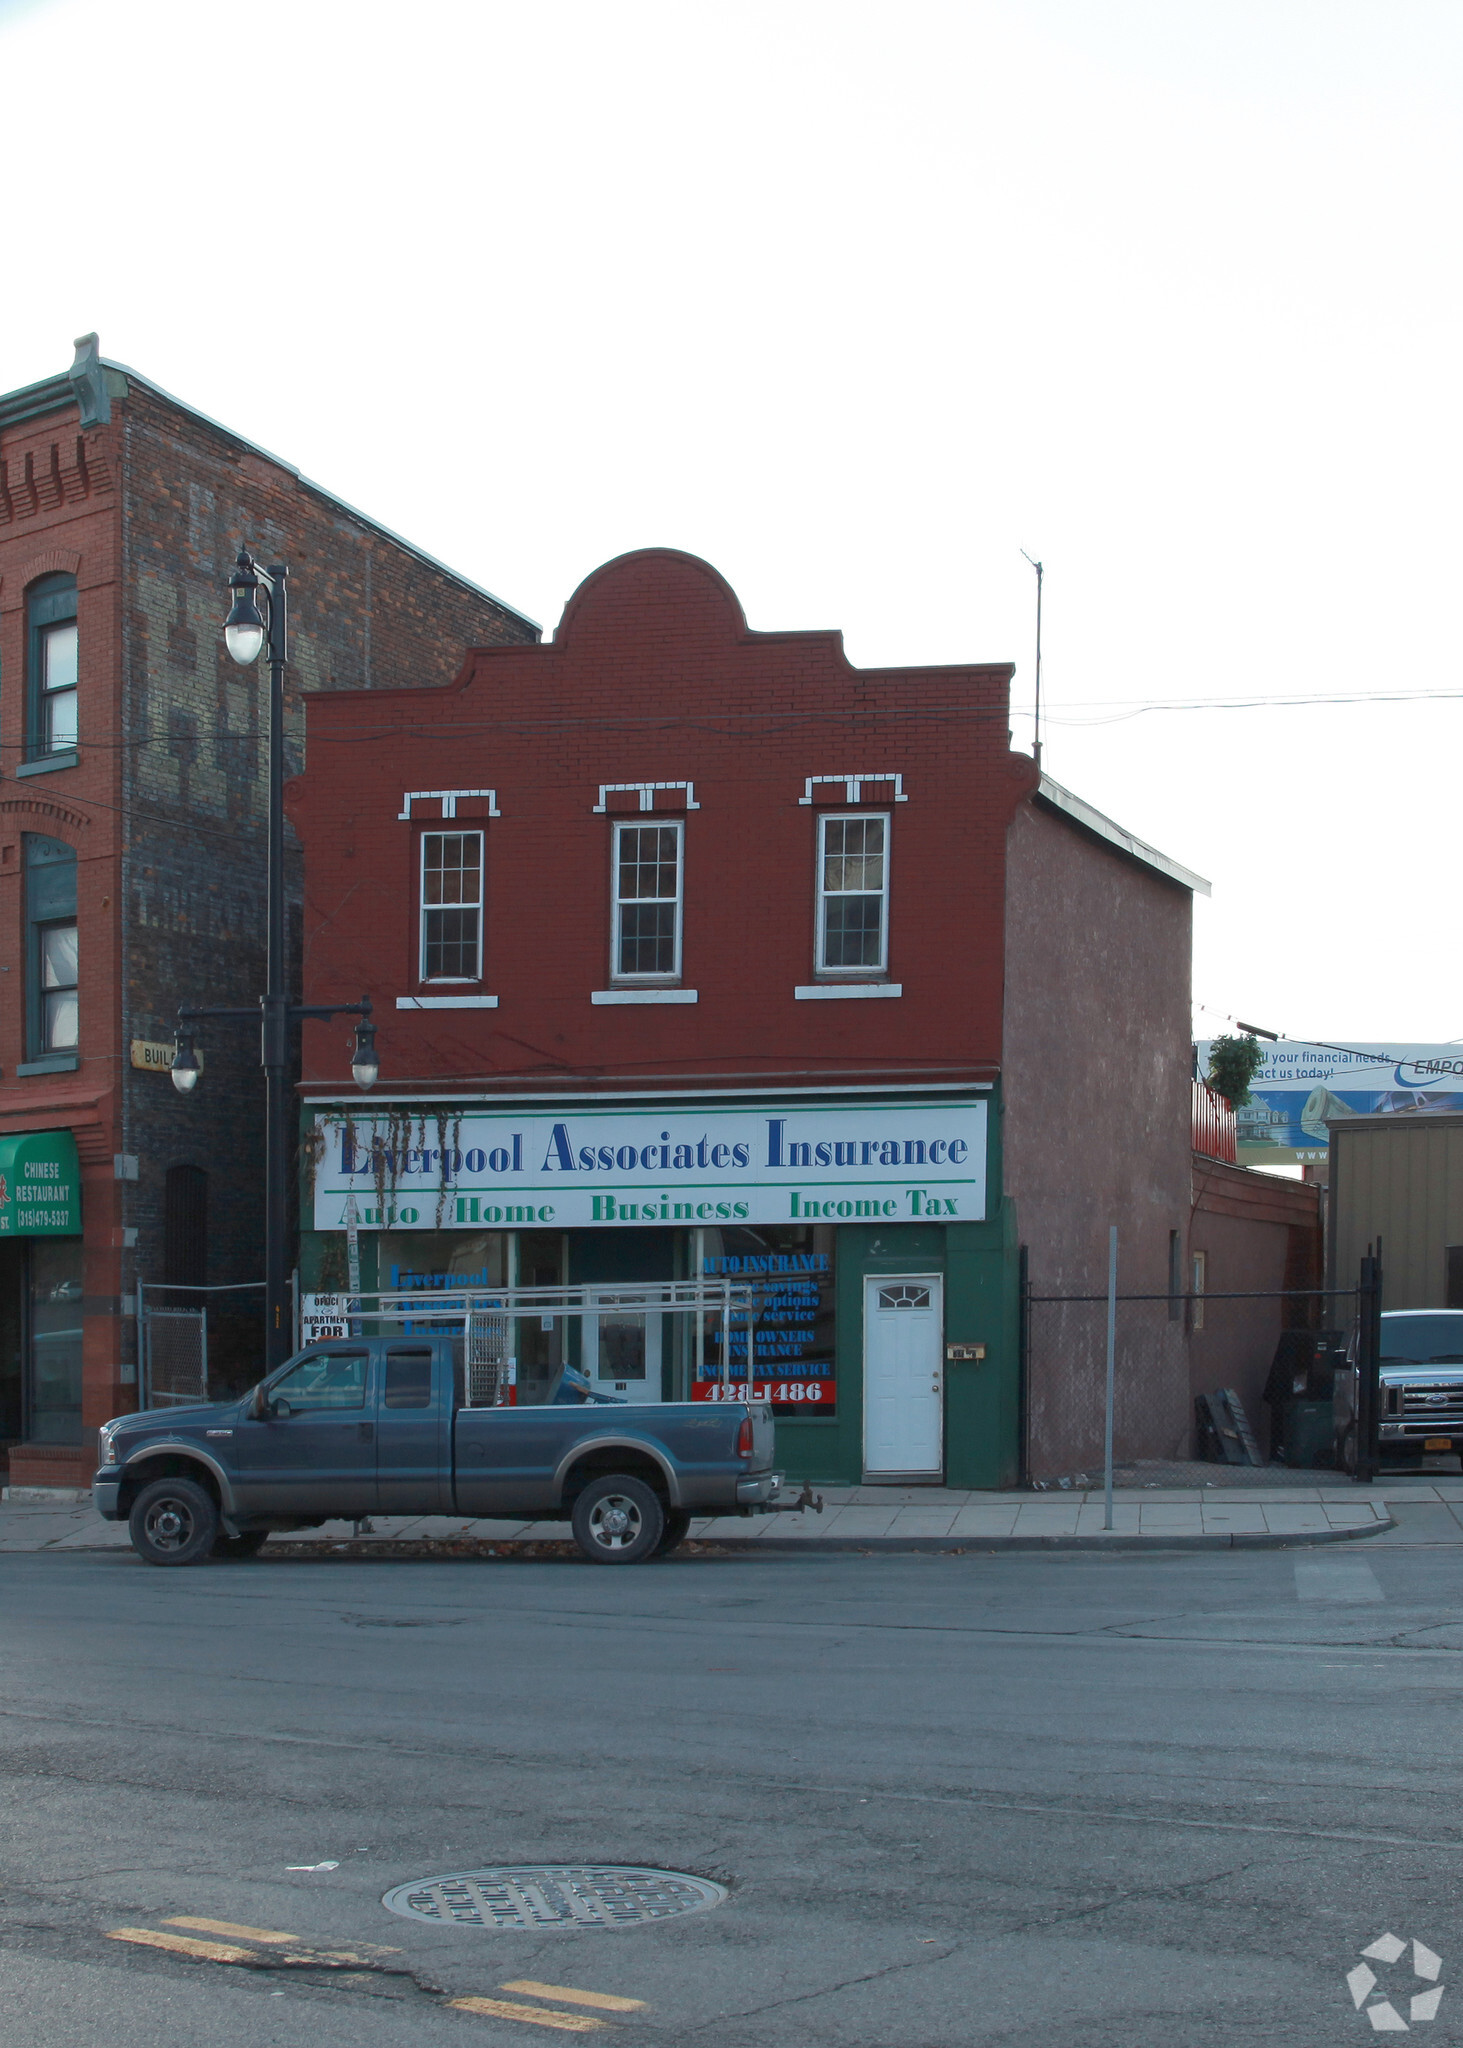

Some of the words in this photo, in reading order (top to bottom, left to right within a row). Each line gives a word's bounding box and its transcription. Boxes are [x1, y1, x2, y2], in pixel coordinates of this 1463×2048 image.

[1272, 1053, 1299, 1065] your
[1302, 1051, 1352, 1063] financial
[1355, 1052, 1394, 1065] needs,
[1279, 1069, 1293, 1079] us
[1296, 1067, 1334, 1081] today!
[337, 1125, 525, 1183] Liverpool
[541, 1123, 750, 1171] Associates
[764, 1118, 969, 1168] Insurance
[24, 1162, 60, 1179] CHINESE
[16, 1185, 70, 1202] RESTAURANT
[337, 1196, 420, 1225] Auto
[454, 1196, 556, 1224] Home
[589, 1193, 750, 1221] Business
[788, 1191, 898, 1219] Income
[905, 1189, 959, 1217] Tax
[17, 1209, 70, 1228] (315)479-5337
[701, 1255, 741, 1274] AUTO
[743, 1254, 830, 1272] INSURANCE
[390, 1264, 489, 1290] Liverpool
[763, 1278, 819, 1297] savings
[764, 1293, 820, 1311] options
[763, 1307, 816, 1322] service
[311, 1325, 343, 1338] FOR
[755, 1330, 816, 1343] OWNERS
[776, 1363, 832, 1377] SERVICE
[705, 1382, 824, 1402] 428-1486
